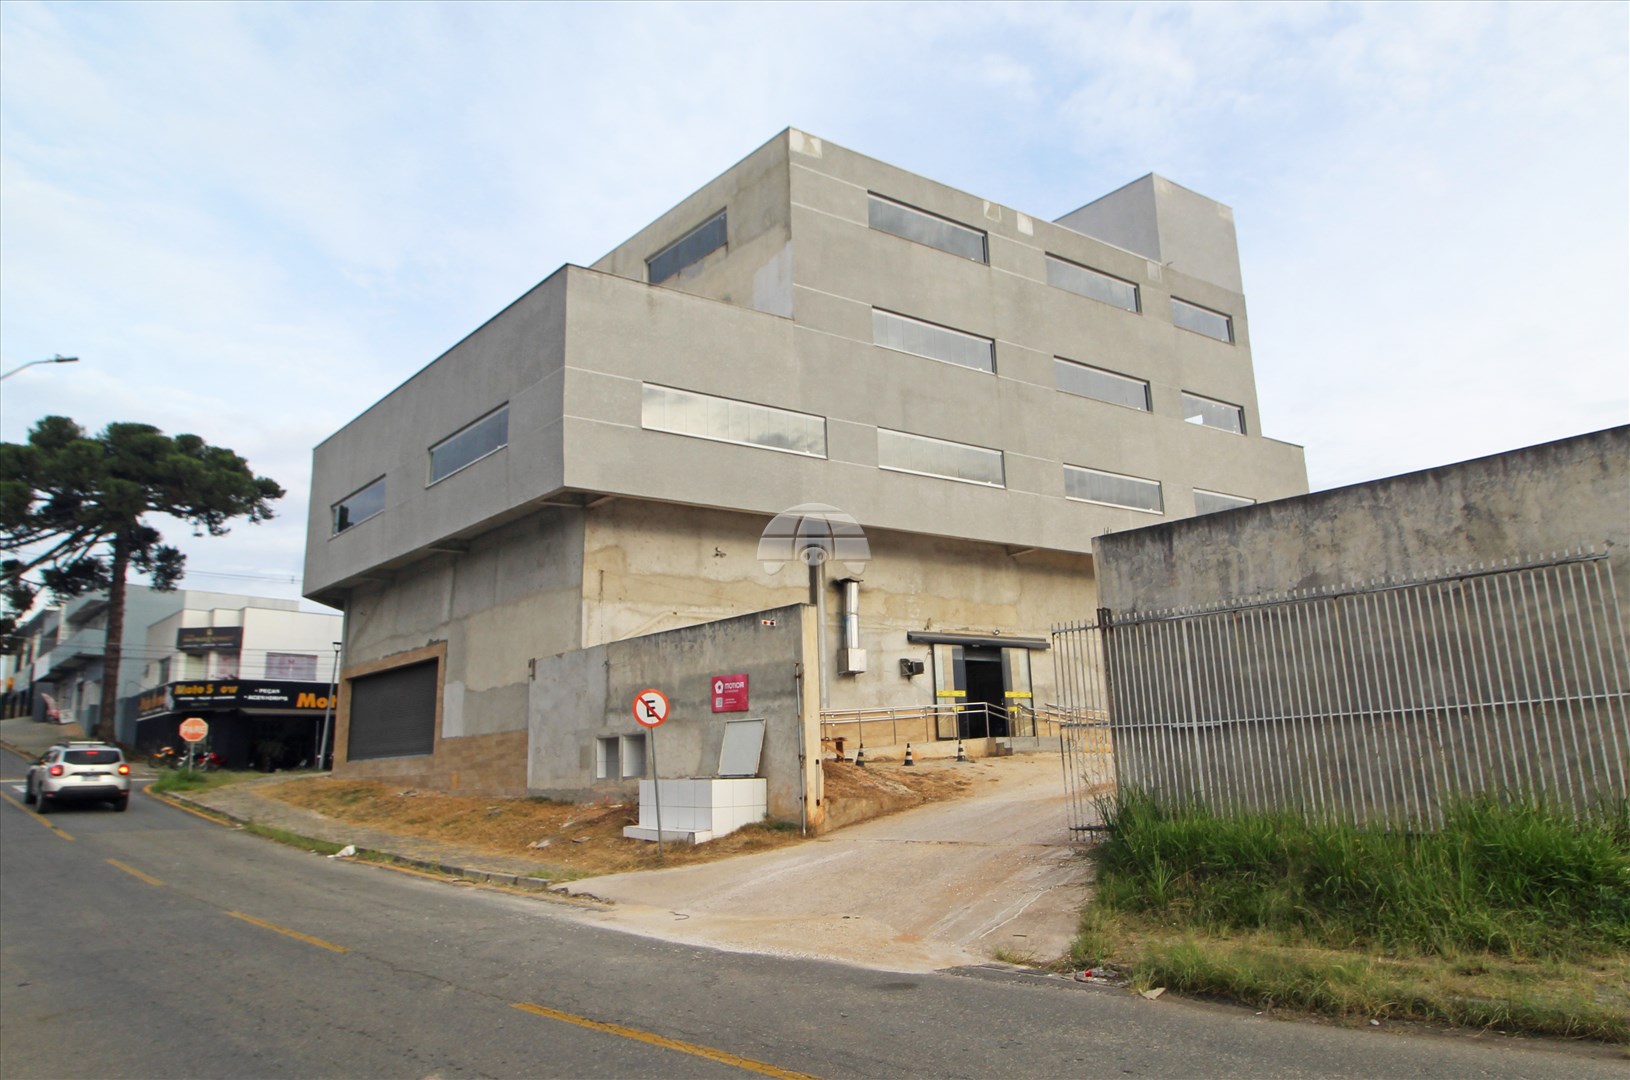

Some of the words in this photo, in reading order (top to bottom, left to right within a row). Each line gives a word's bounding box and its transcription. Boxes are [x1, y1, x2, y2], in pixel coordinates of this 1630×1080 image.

[206, 684, 238, 694] Sow
[645, 700, 656, 717] E
[182, 725, 206, 735] PARE
